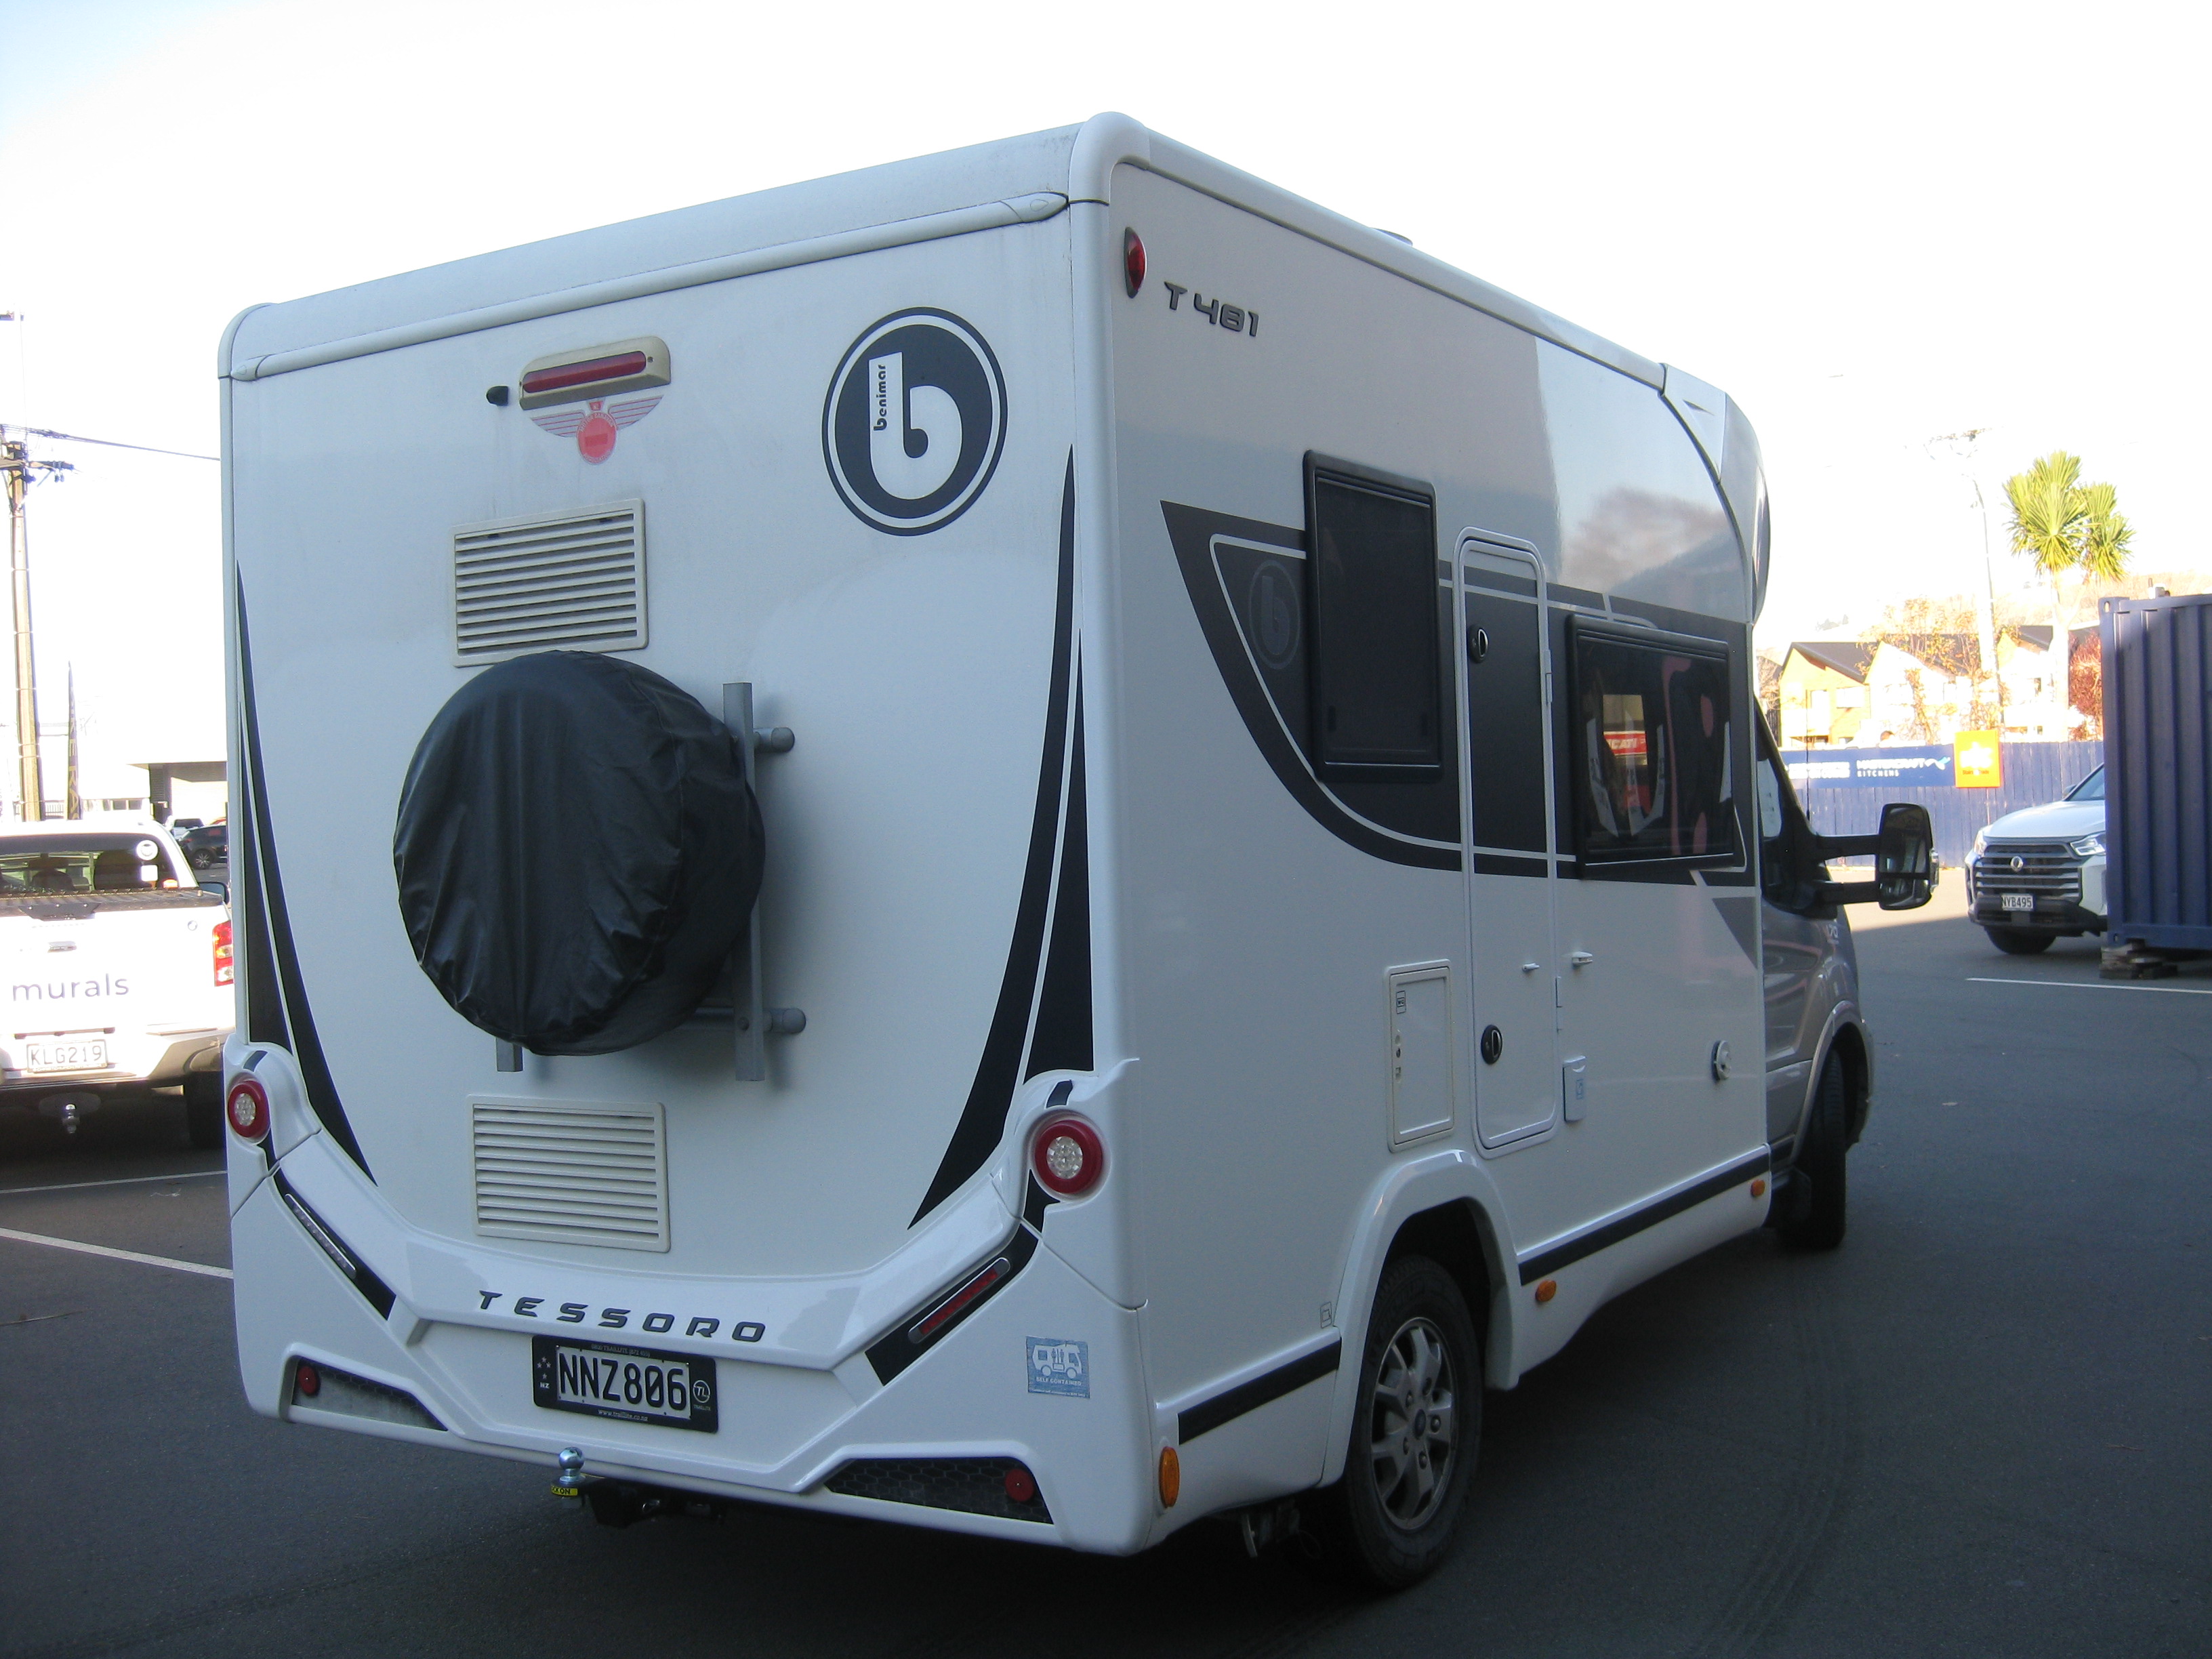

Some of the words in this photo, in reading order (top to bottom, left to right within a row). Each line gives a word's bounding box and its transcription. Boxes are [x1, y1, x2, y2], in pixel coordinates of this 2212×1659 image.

[873, 364, 887, 432] benimar
[1857, 769, 1900, 777] KITCHENS
[2002, 896, 2032, 907] NYB495
[12, 974, 129, 1001] murals
[30, 1045, 102, 1065] KLG219
[479, 1290, 766, 1343] TESSORO
[558, 1353, 687, 1412] NNZ806
[1050, 1377, 1082, 1386] CONTAINED
